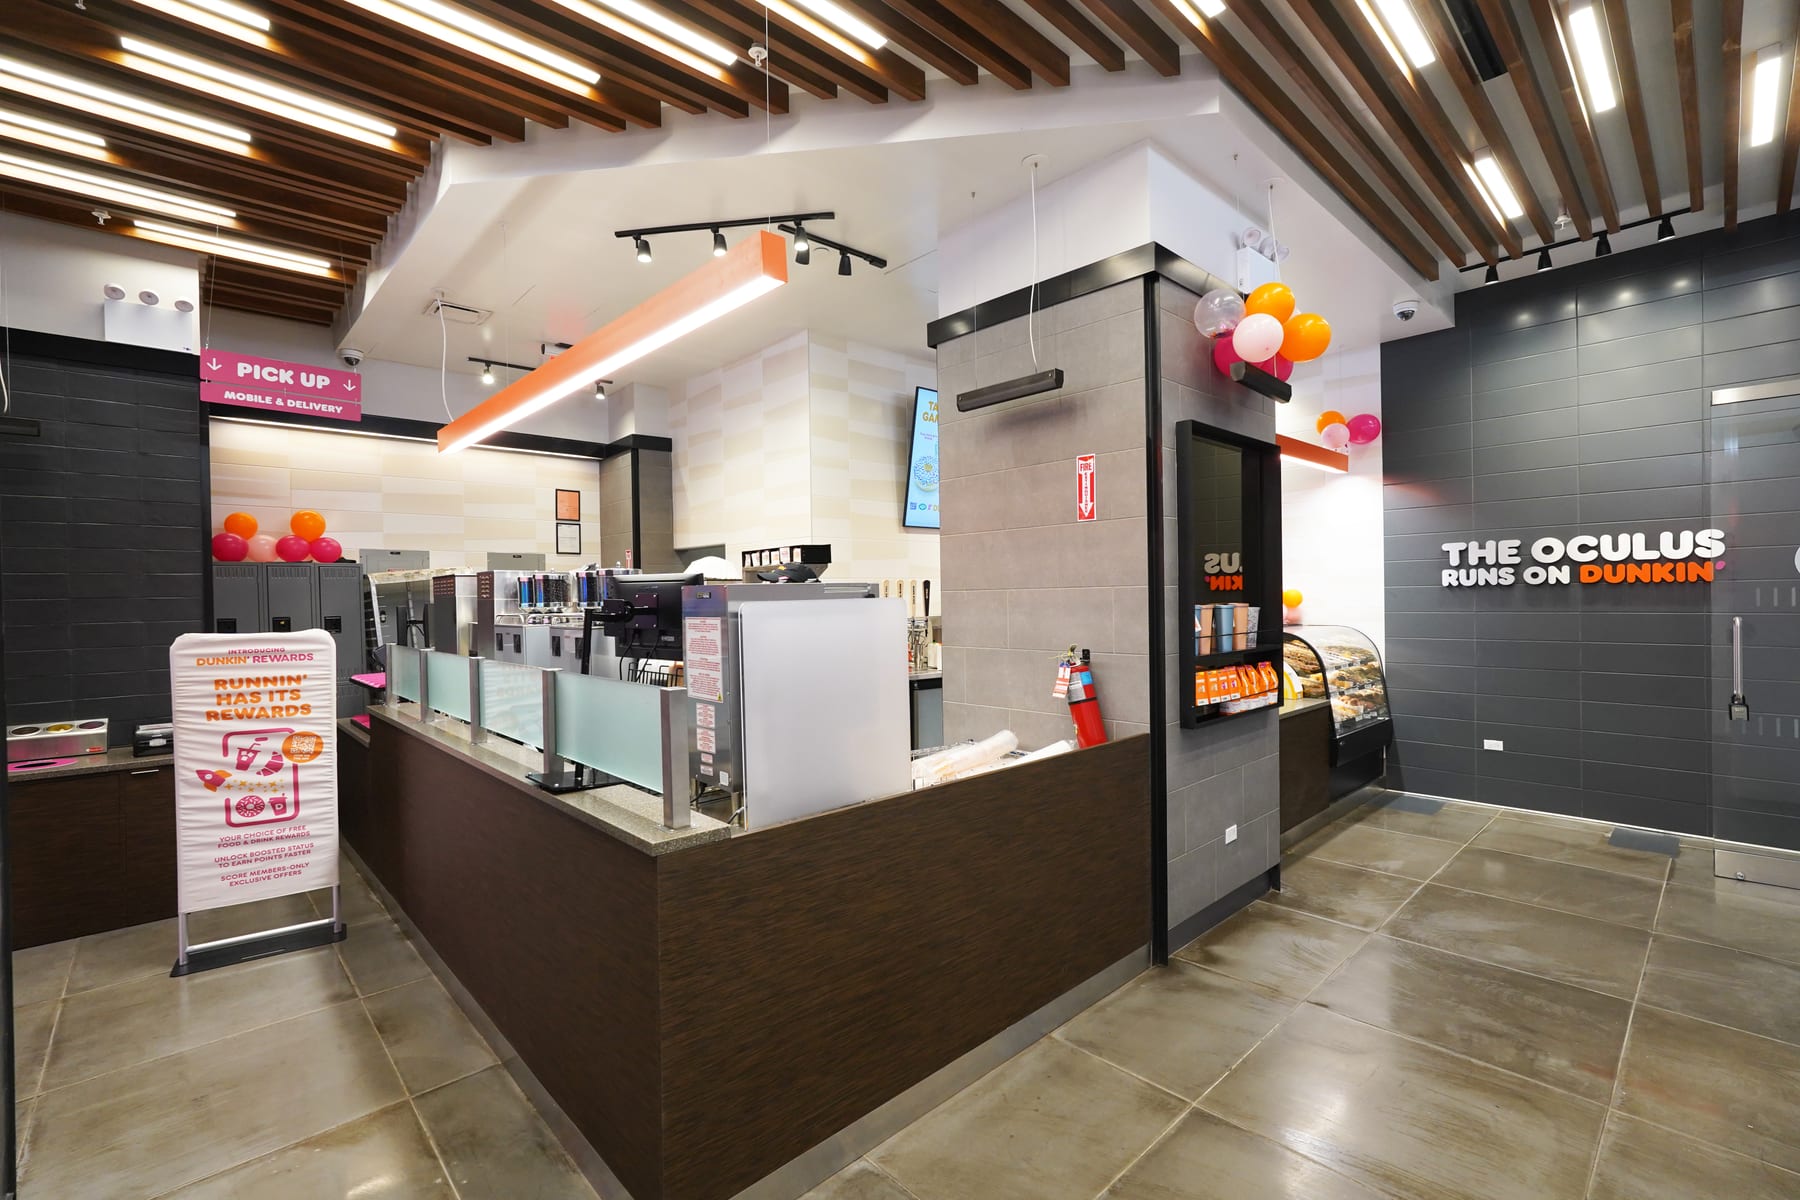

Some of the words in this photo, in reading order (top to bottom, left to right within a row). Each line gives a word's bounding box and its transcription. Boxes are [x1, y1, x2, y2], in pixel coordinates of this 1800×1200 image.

[237, 362, 294, 385] PICK
[300, 372, 331, 390] UP
[224, 390, 273, 405] MOBILE
[276, 398, 284, 406] &
[287, 400, 343, 414] DELIVERY
[1080, 462, 1092, 472] FIRE
[1441, 538, 1522, 567] THE
[1530, 528, 1726, 564] OCULUS
[1441, 566, 1516, 588] RUNS
[1522, 564, 1571, 585] ON
[1579, 560, 1726, 584] DUNKIN'
[196, 656, 250, 666] DUNKIN'
[252, 653, 314, 664] REWARDS
[214, 674, 308, 690] RUNNIN'
[216, 691, 262, 706] HAS
[268, 688, 302, 702] ITS
[205, 703, 312, 722] REWARDS
[219, 834, 242, 843] YOUR
[243, 829, 274, 839] CHOICE
[250, 837, 273, 845] DRINK
[275, 830, 311, 841] REWARDS
[214, 854, 248, 863] UNLOCK
[250, 847, 286, 858] BOOSTED
[287, 843, 314, 851] STATUS
[254, 853, 283, 863] POINTS
[284, 849, 311, 858] FASTER
[220, 873, 248, 882] SCORE
[249, 862, 310, 876] MEMBERS-ONLY
[229, 875, 272, 887] EXCLUSIVE
[273, 869, 302, 879] OFFERS
